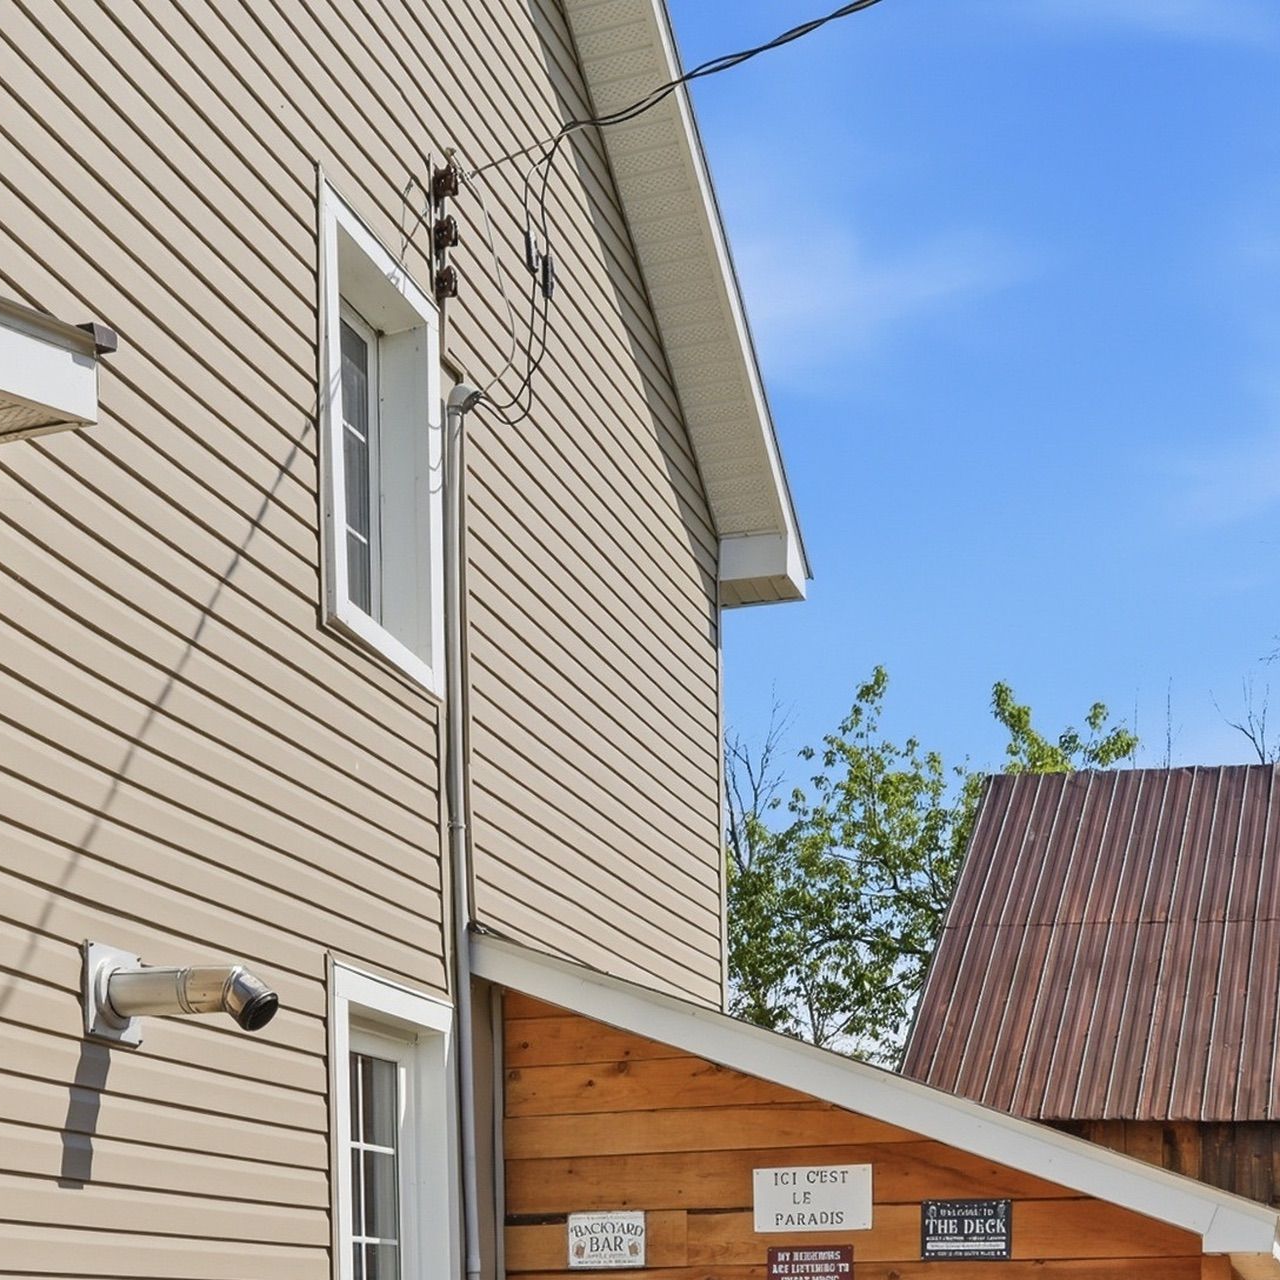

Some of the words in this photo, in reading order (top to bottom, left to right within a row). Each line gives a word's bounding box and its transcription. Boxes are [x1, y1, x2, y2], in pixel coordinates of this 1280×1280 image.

[774, 1171, 797, 1186] ICI
[806, 1170, 849, 1184] C'EST
[792, 1191, 812, 1205] LE
[774, 1211, 844, 1226] PARADIS
[925, 1218, 958, 1235] THE
[963, 1218, 1007, 1234] DECK
[573, 1221, 644, 1238] BACKYARD
[589, 1236, 624, 1252] BAR
